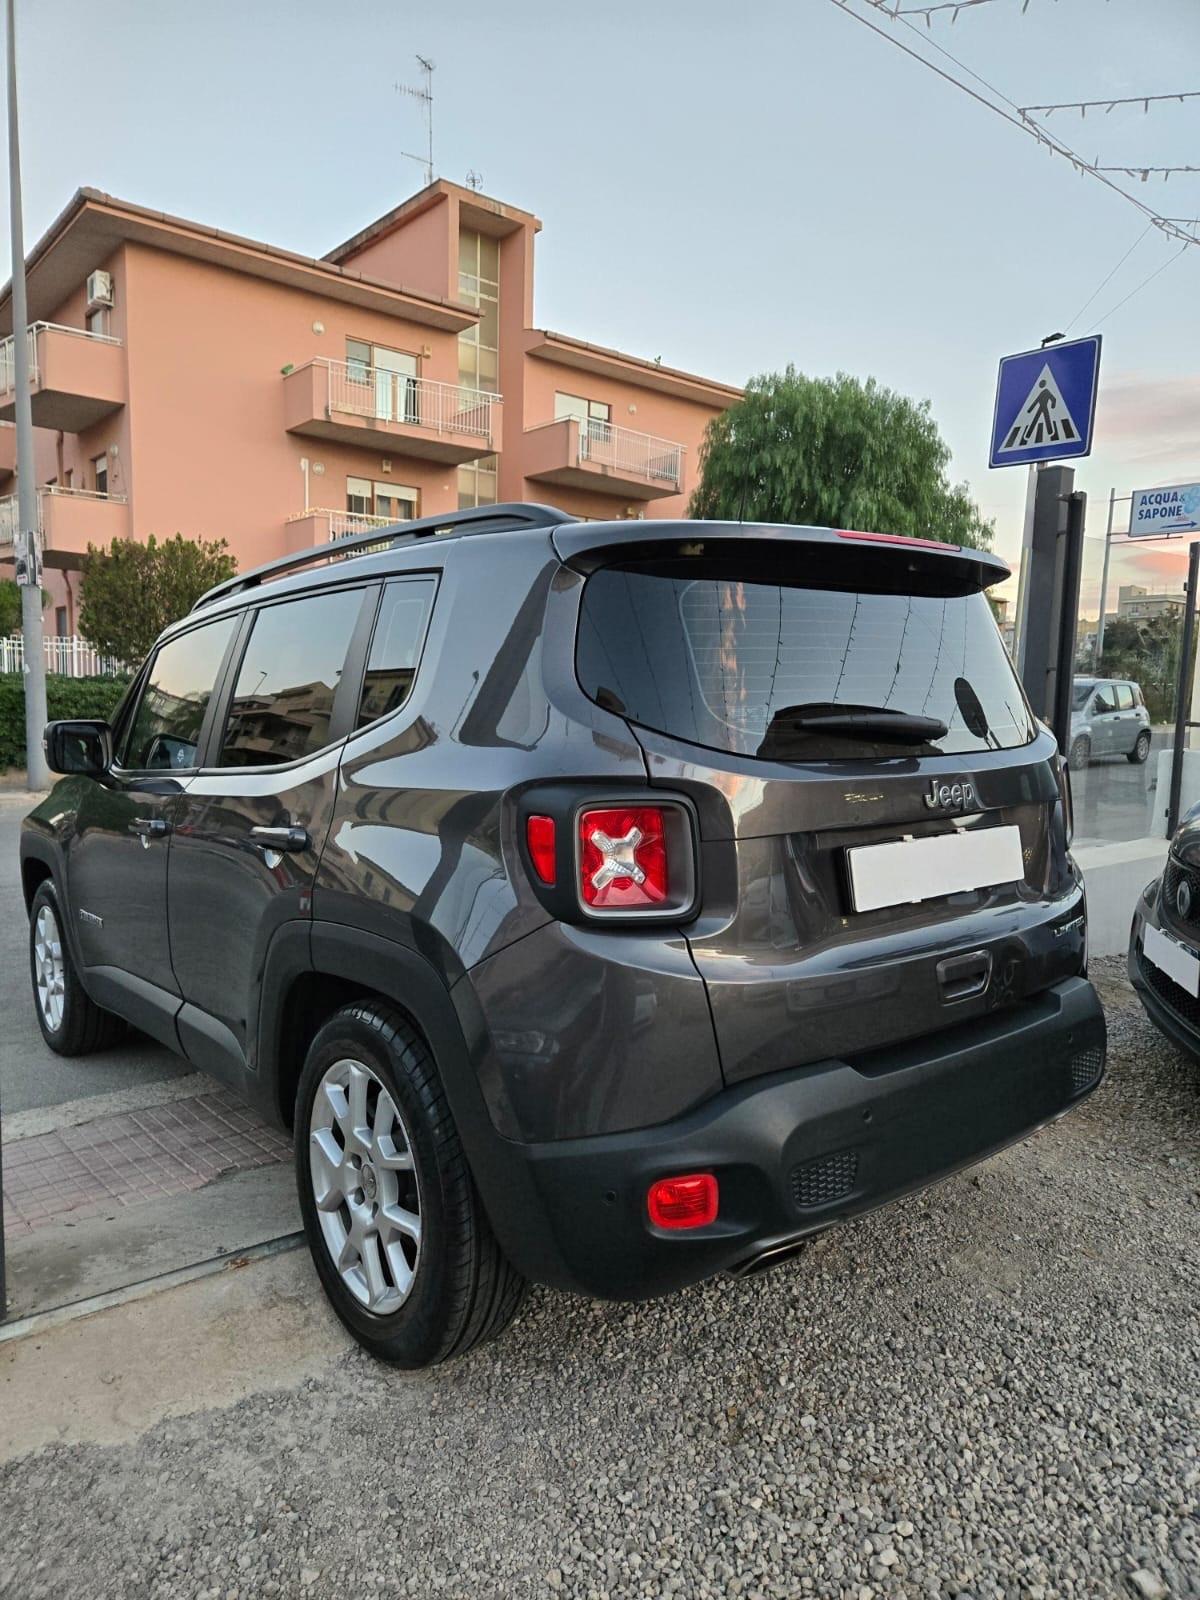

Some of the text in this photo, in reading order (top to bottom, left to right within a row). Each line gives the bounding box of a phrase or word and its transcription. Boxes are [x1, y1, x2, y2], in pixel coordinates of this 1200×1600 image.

[1140, 491, 1178, 506] ACQUA
[1138, 505, 1183, 520] SAPONE
[924, 780, 975, 809] Jeep
